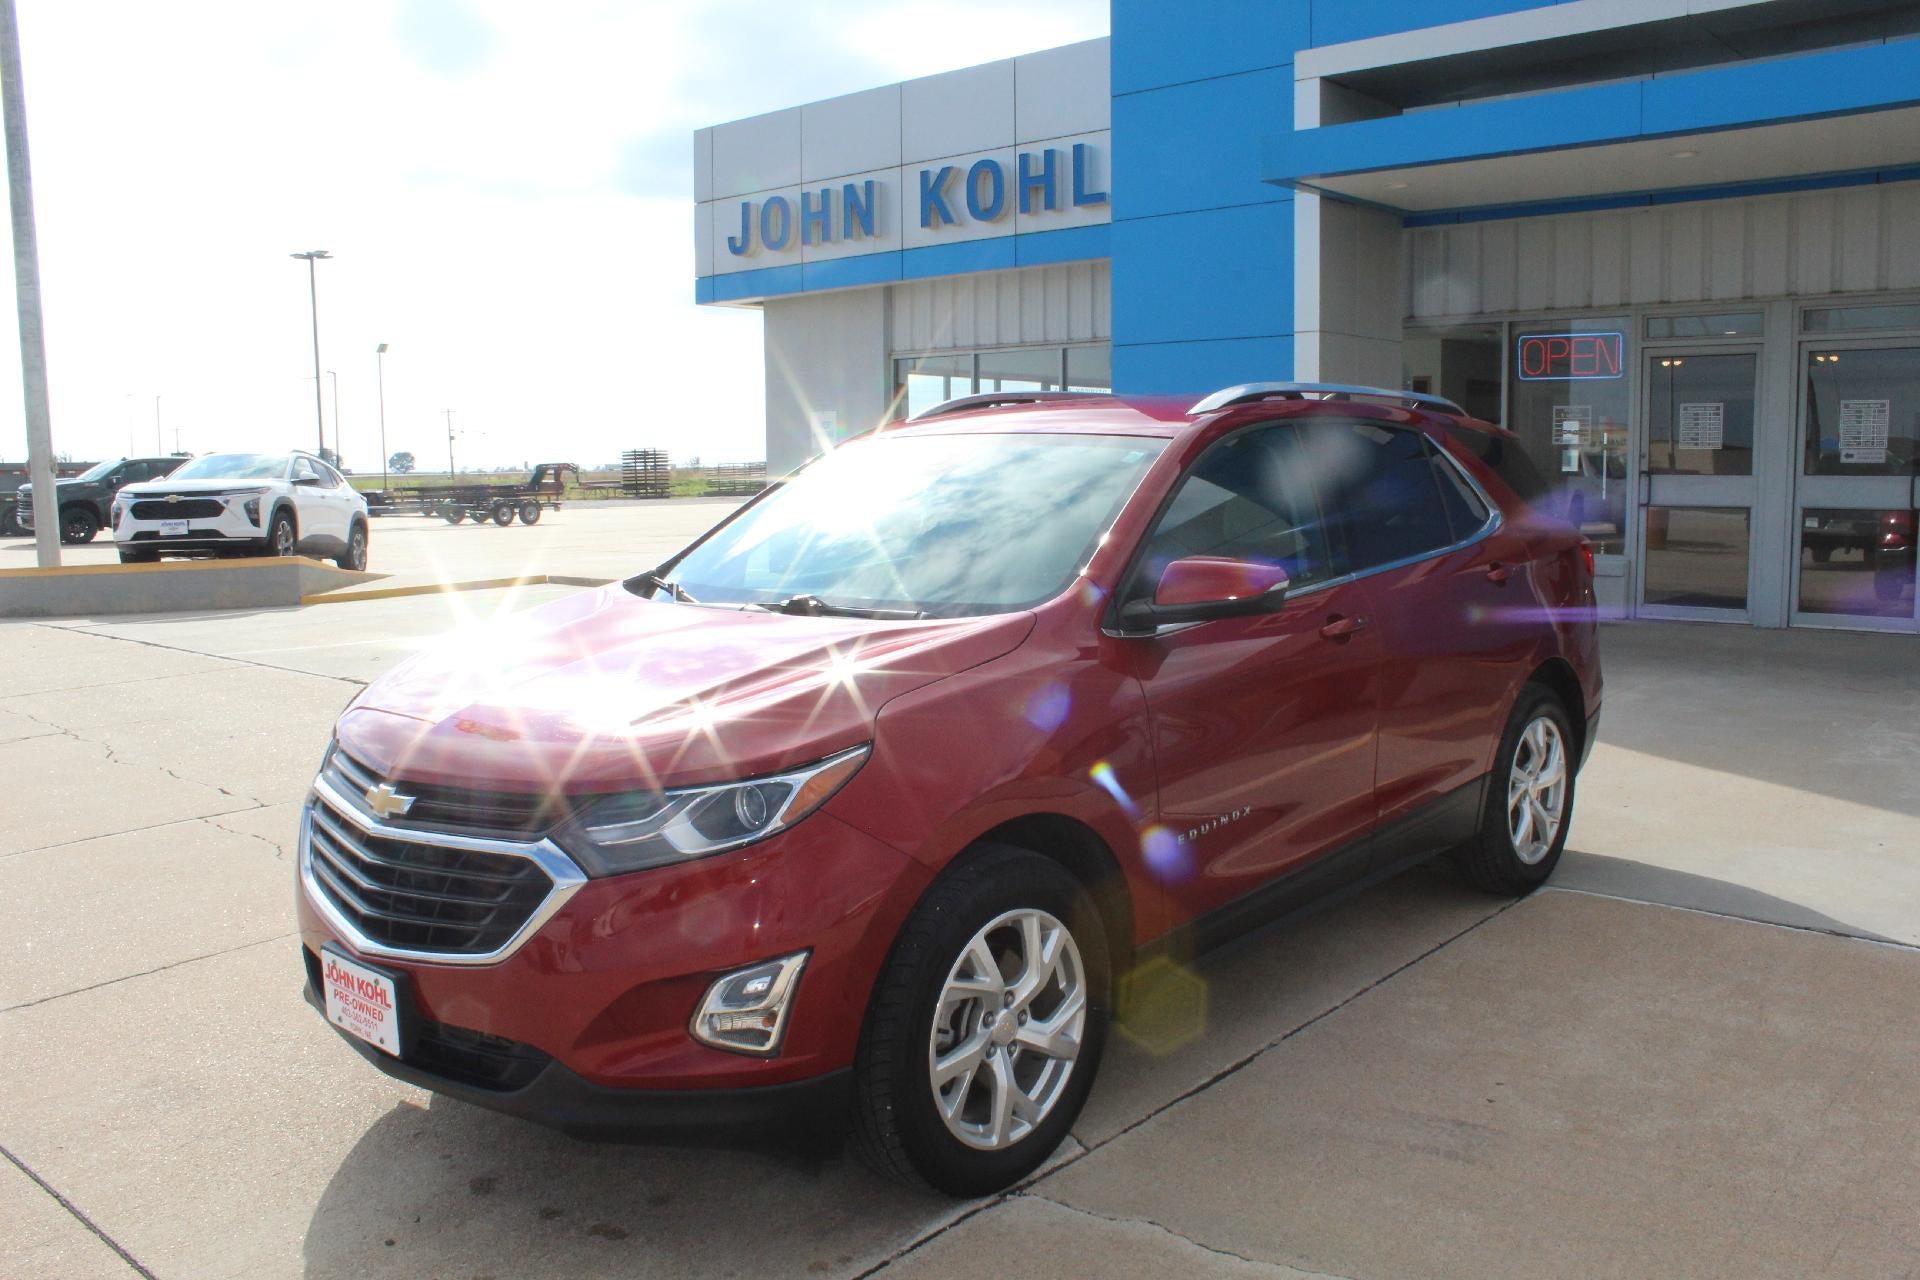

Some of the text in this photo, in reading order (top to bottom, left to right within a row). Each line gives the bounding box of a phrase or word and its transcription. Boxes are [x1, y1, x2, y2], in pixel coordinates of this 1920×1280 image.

[727, 143, 1108, 256] JOHN KOHL
[1523, 336, 1619, 375] OPEN
[1177, 805, 1251, 845] EQUINOX
[326, 963, 392, 1009] JOHN KOHL
[333, 989, 384, 1022] PRE-OWNED
